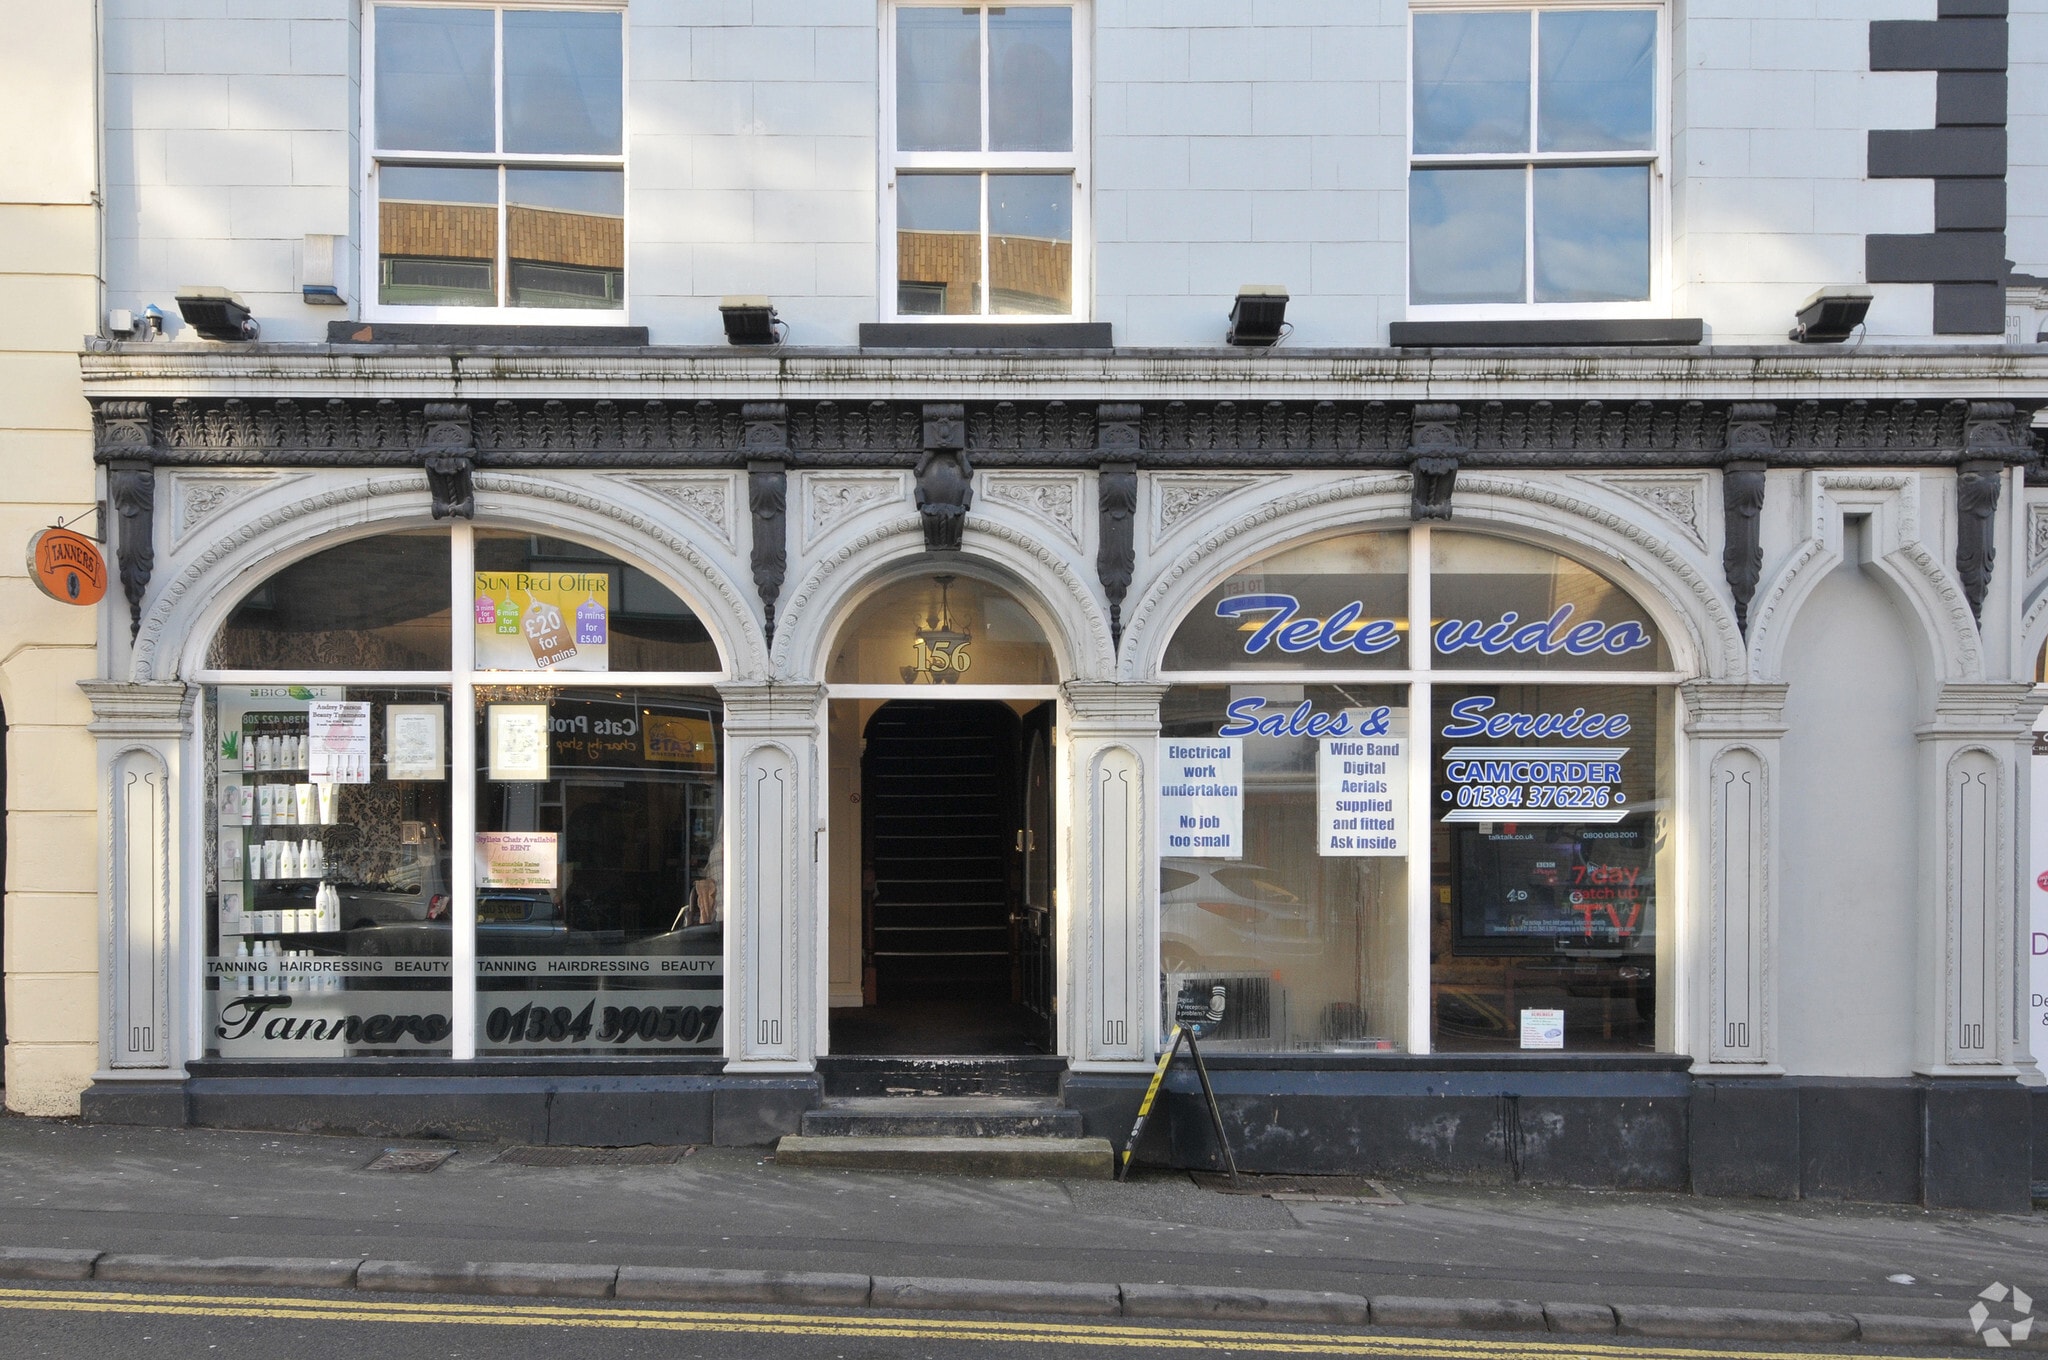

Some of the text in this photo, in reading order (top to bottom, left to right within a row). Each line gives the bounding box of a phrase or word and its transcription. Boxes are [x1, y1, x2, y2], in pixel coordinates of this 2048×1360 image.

[52, 544, 94, 572] TANNERS
[477, 573, 510, 590] SUN
[577, 611, 605, 620] 9 mins
[525, 611, 560, 639] £20
[1215, 593, 1651, 656] Tele video
[539, 635, 558, 651] for
[580, 635, 602, 644] £5.00
[537, 647, 576, 668] 60 mins
[913, 640, 971, 672] 156
[260, 688, 327, 697] BIOLAGE
[1218, 696, 1631, 739] Sales & Service
[1169, 746, 1231, 759] Electrical
[1330, 743, 1400, 756] Wide Band
[1184, 765, 1216, 777] work
[1343, 761, 1386, 776] Digital
[1447, 761, 1622, 783] CAMCORDER
[1162, 783, 1238, 797] undertaken
[1341, 780, 1388, 793] Aerials
[1457, 785, 1610, 807] 01384 376226
[1336, 799, 1392, 813] supplied
[1180, 815, 1220, 829] No job
[1333, 817, 1395, 831] and fitted
[1169, 834, 1230, 847] too small
[1330, 836, 1397, 849] Ask inside
[1488, 833, 1534, 841] talktalk.co.uk
[1572, 864, 1639, 888] 7 day
[1618, 888, 1639, 901] up
[1572, 903, 1641, 937] TV
[208, 961, 450, 972] TANNING HAIRDRESSING BEAUTY
[477, 960, 716, 972] TANNING HAIRDRESSING BEAUTY
[216, 995, 453, 1045] Tanners
[486, 997, 724, 1044] 01384 390507
